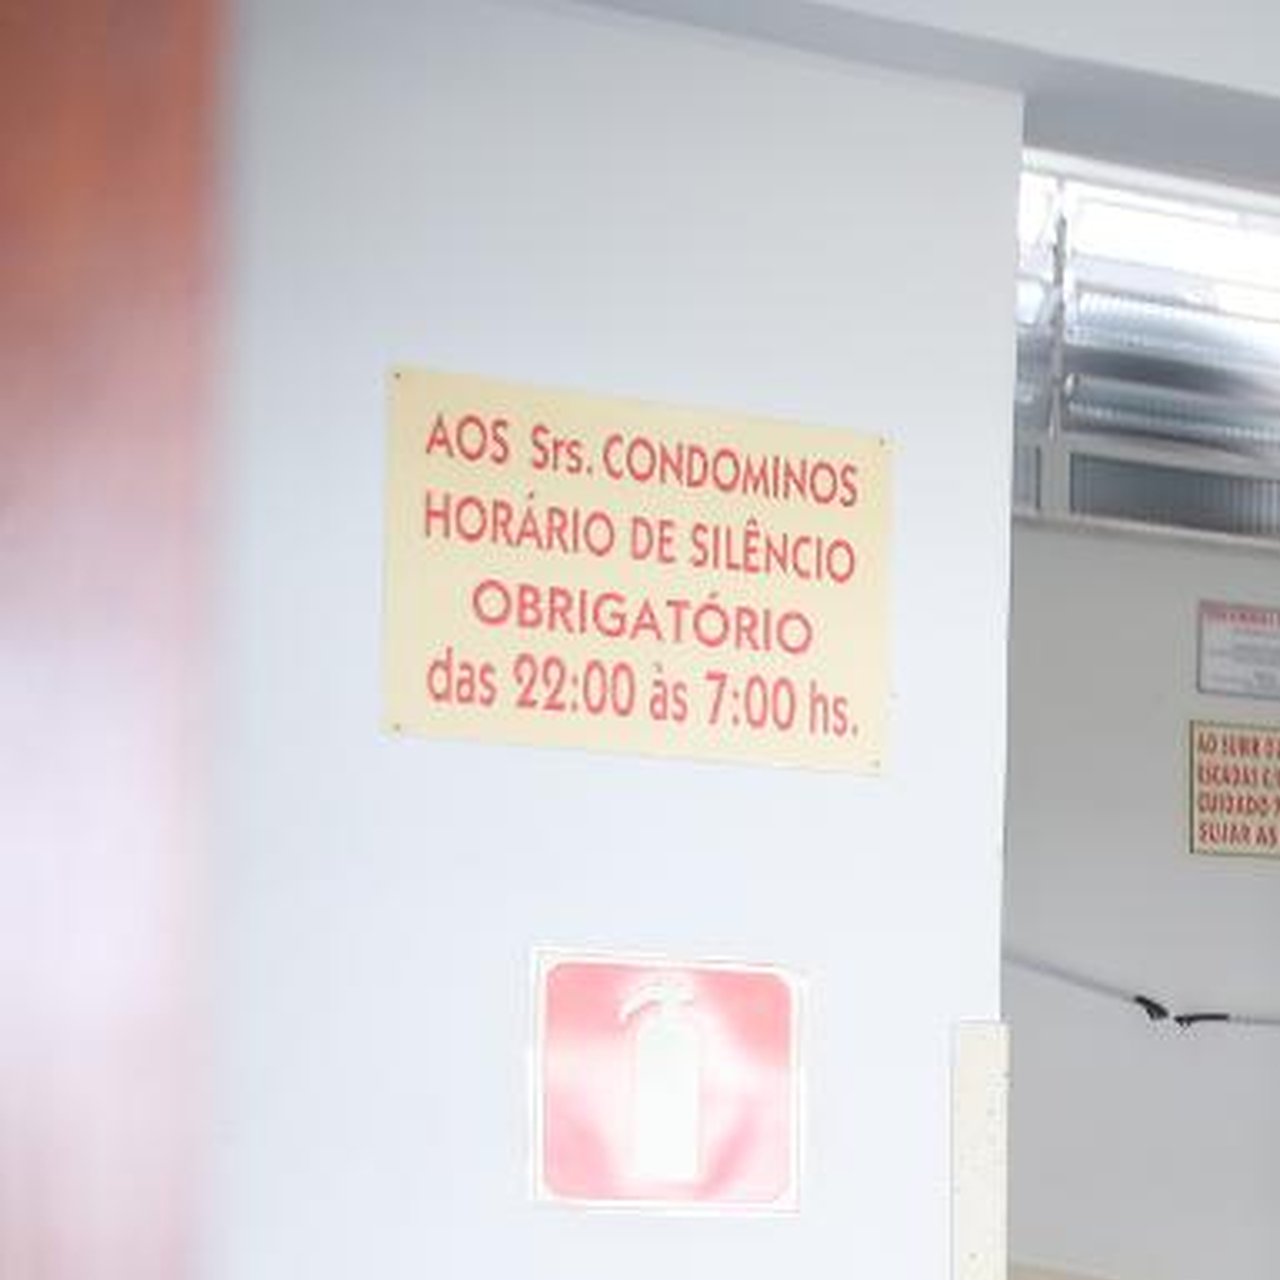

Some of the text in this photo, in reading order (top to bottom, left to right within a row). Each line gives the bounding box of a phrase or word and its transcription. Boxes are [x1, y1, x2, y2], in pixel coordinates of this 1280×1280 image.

[425, 412, 860, 509] AOS Srs. CONDOMINOS
[424, 490, 857, 585] HORÁRIO DE SILÊNCIO
[472, 577, 814, 656] OBRIGATÓRIO
[426, 645, 861, 738] das 22:00 às 7:00 hs.
[1256, 826, 1278, 847] AS
